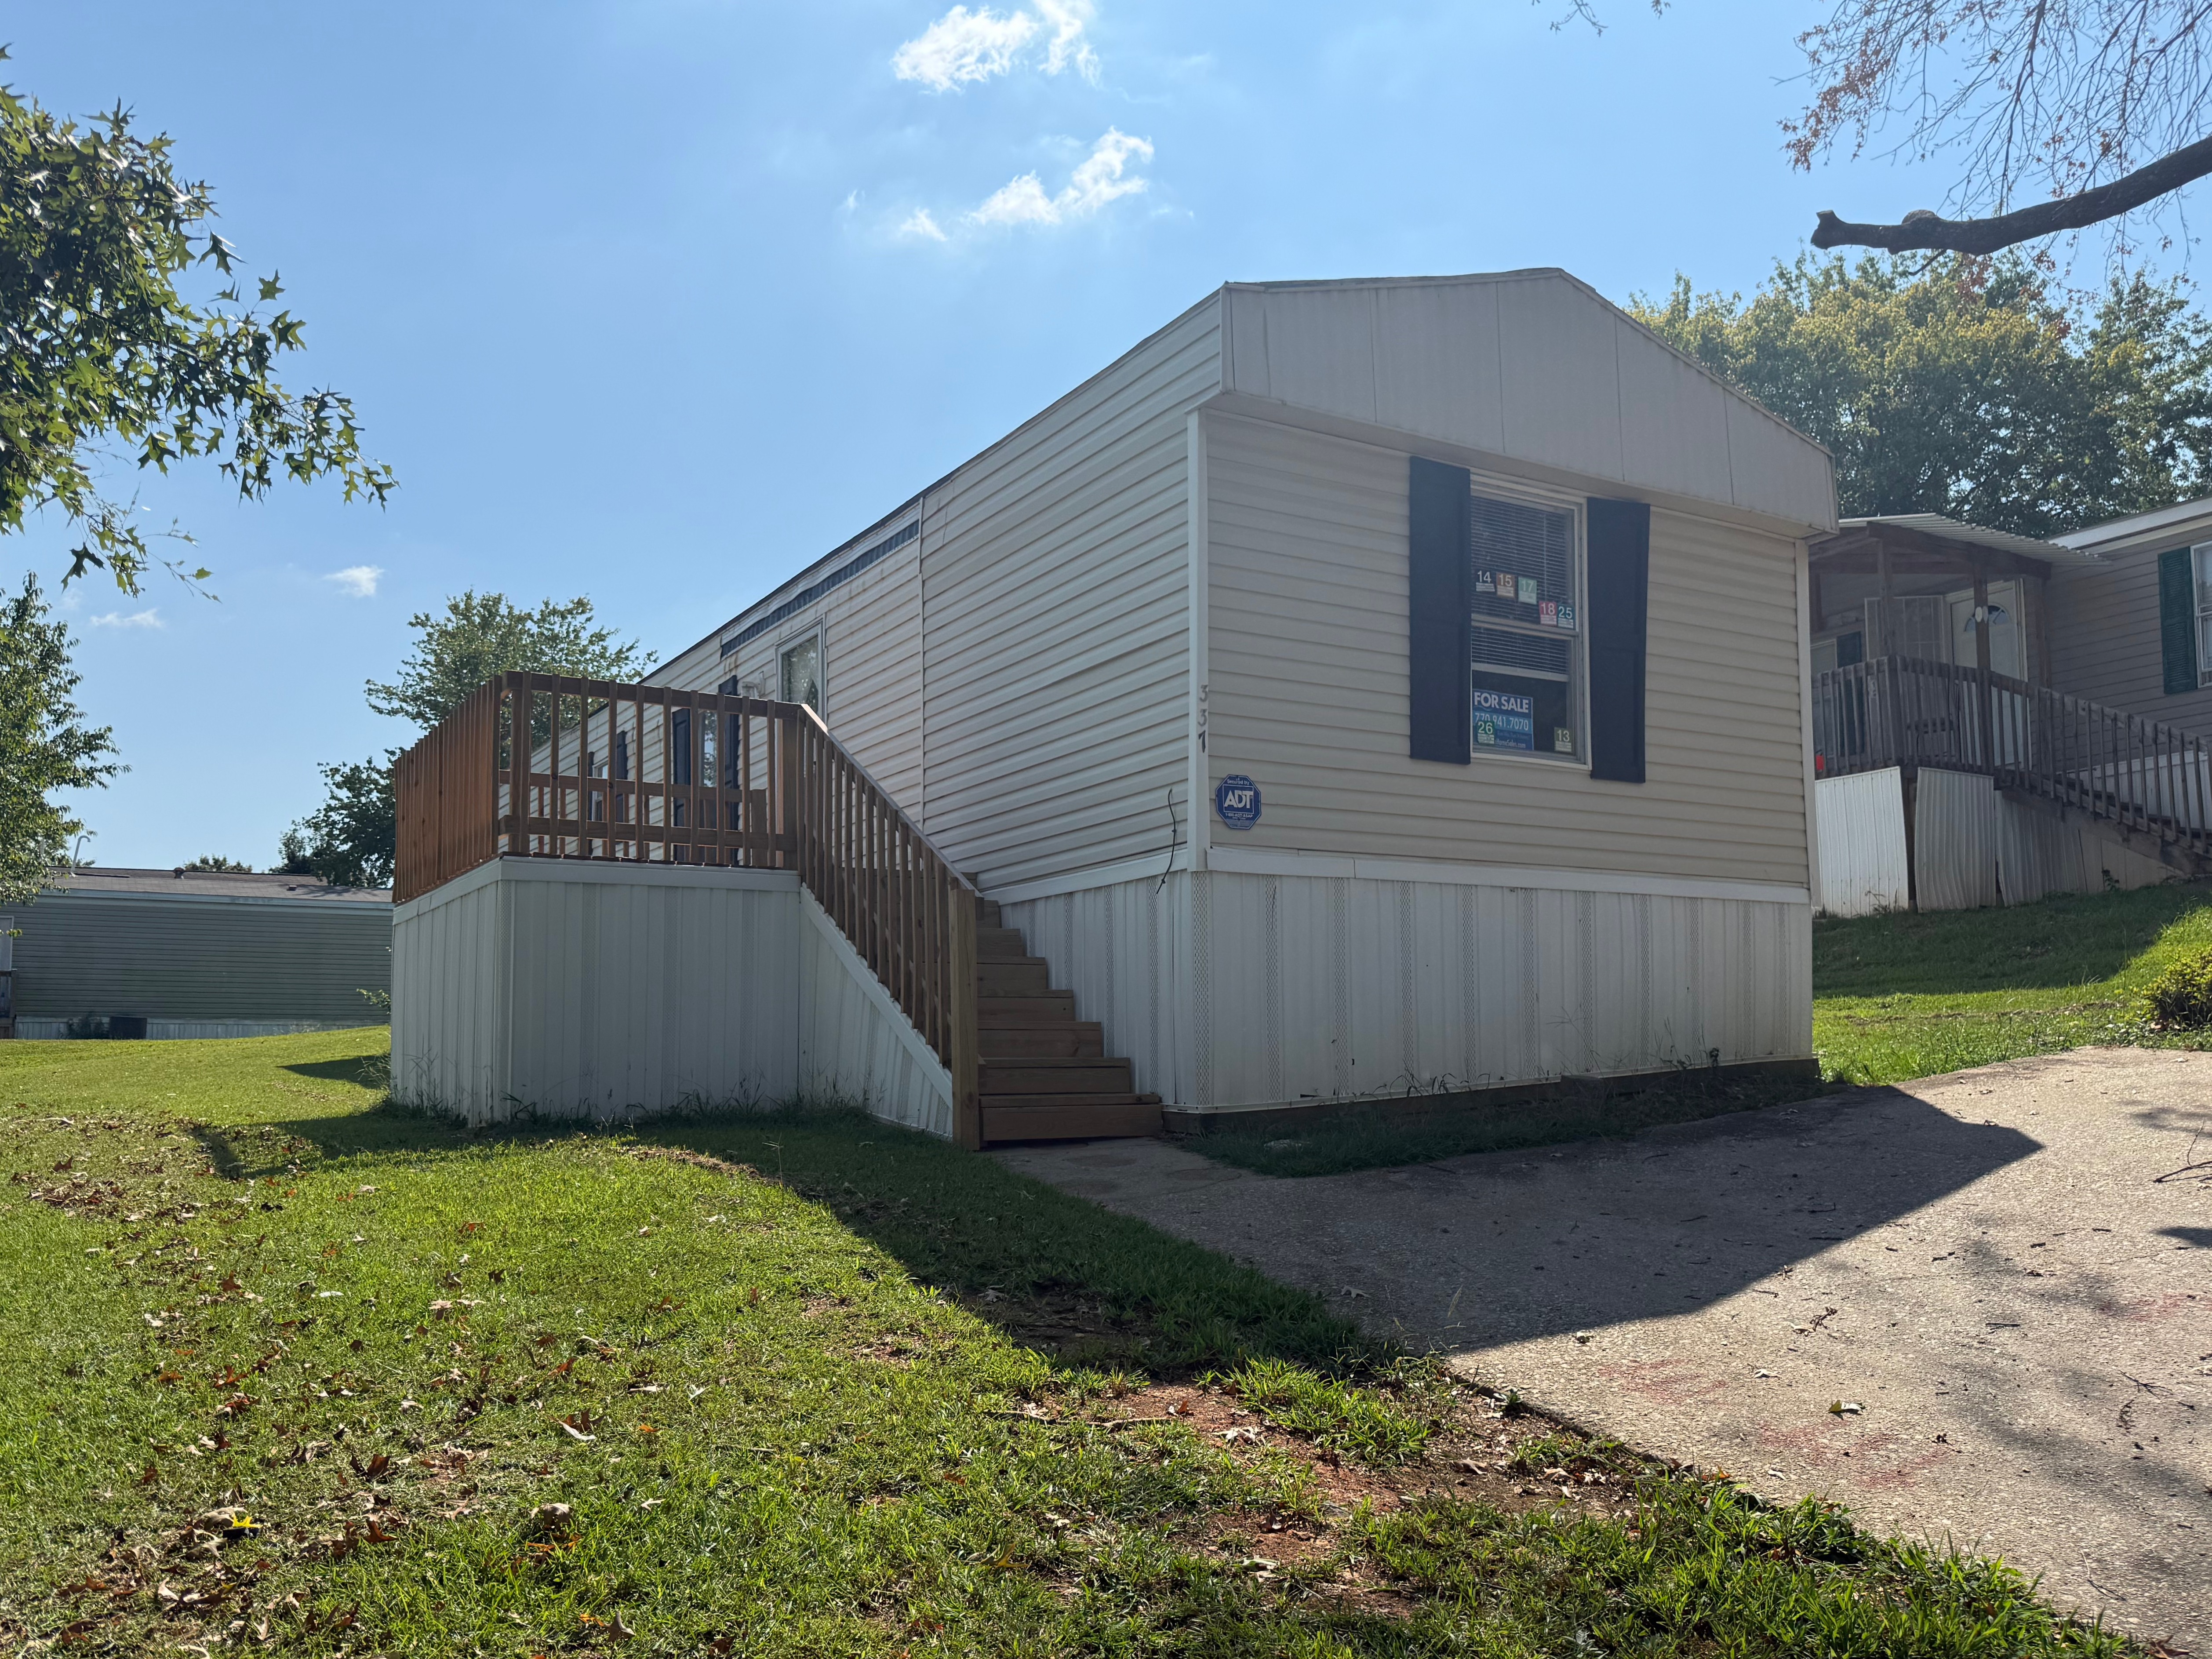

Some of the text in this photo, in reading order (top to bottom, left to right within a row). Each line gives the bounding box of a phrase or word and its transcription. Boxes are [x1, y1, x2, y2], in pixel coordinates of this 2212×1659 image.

[1477, 571, 1492, 583] 14
[1499, 574, 1512, 586] 15
[1521, 580, 1534, 592] 17
[1541, 603, 1555, 615] 18
[1558, 606, 1572, 619] 25
[1474, 692, 1528, 713] FOR SALE
[1475, 713, 1529, 731] 770941.7070
[1478, 721, 1493, 734] 26
[1557, 730, 1570, 742] 13
[1224, 790, 1253, 808] ADT
